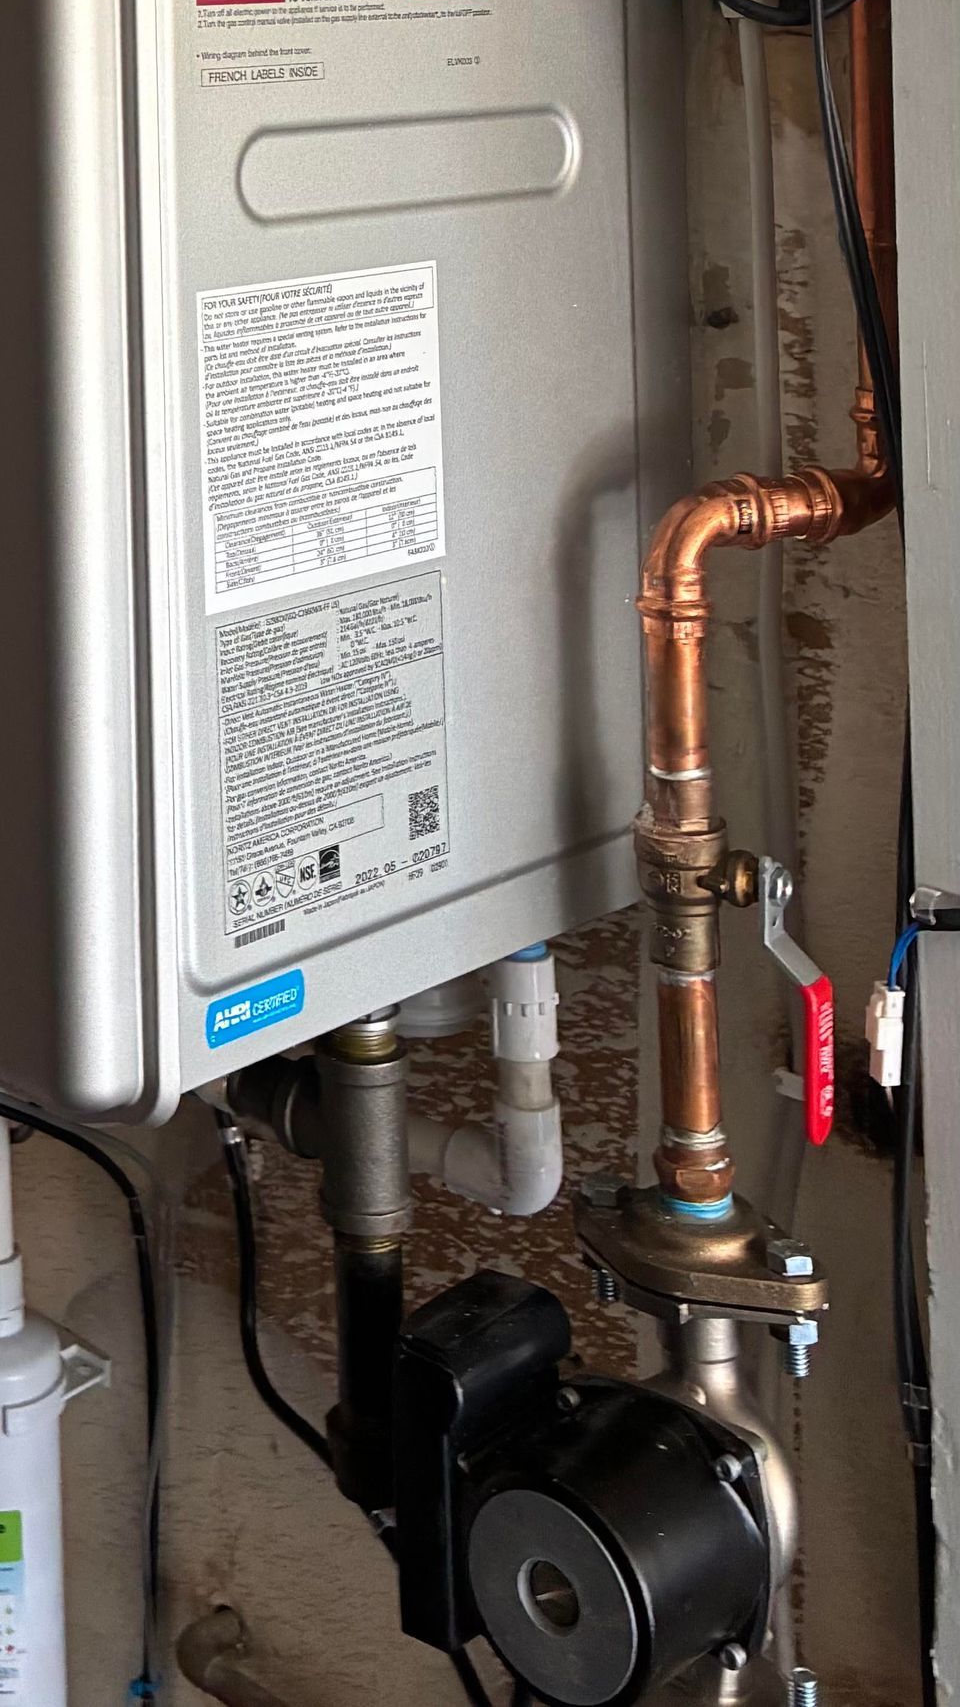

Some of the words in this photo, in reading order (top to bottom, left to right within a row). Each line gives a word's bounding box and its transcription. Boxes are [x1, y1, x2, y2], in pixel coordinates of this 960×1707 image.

[209, 70, 246, 83] FRENCH
[251, 68, 283, 80] LABELS
[289, 66, 317, 77] INSIDE
[204, 301, 216, 310] FOR
[218, 298, 235, 308] YOUR
[281, 289, 300, 299] VOTRE
[252, 988, 298, 1016] CERTIFIED
